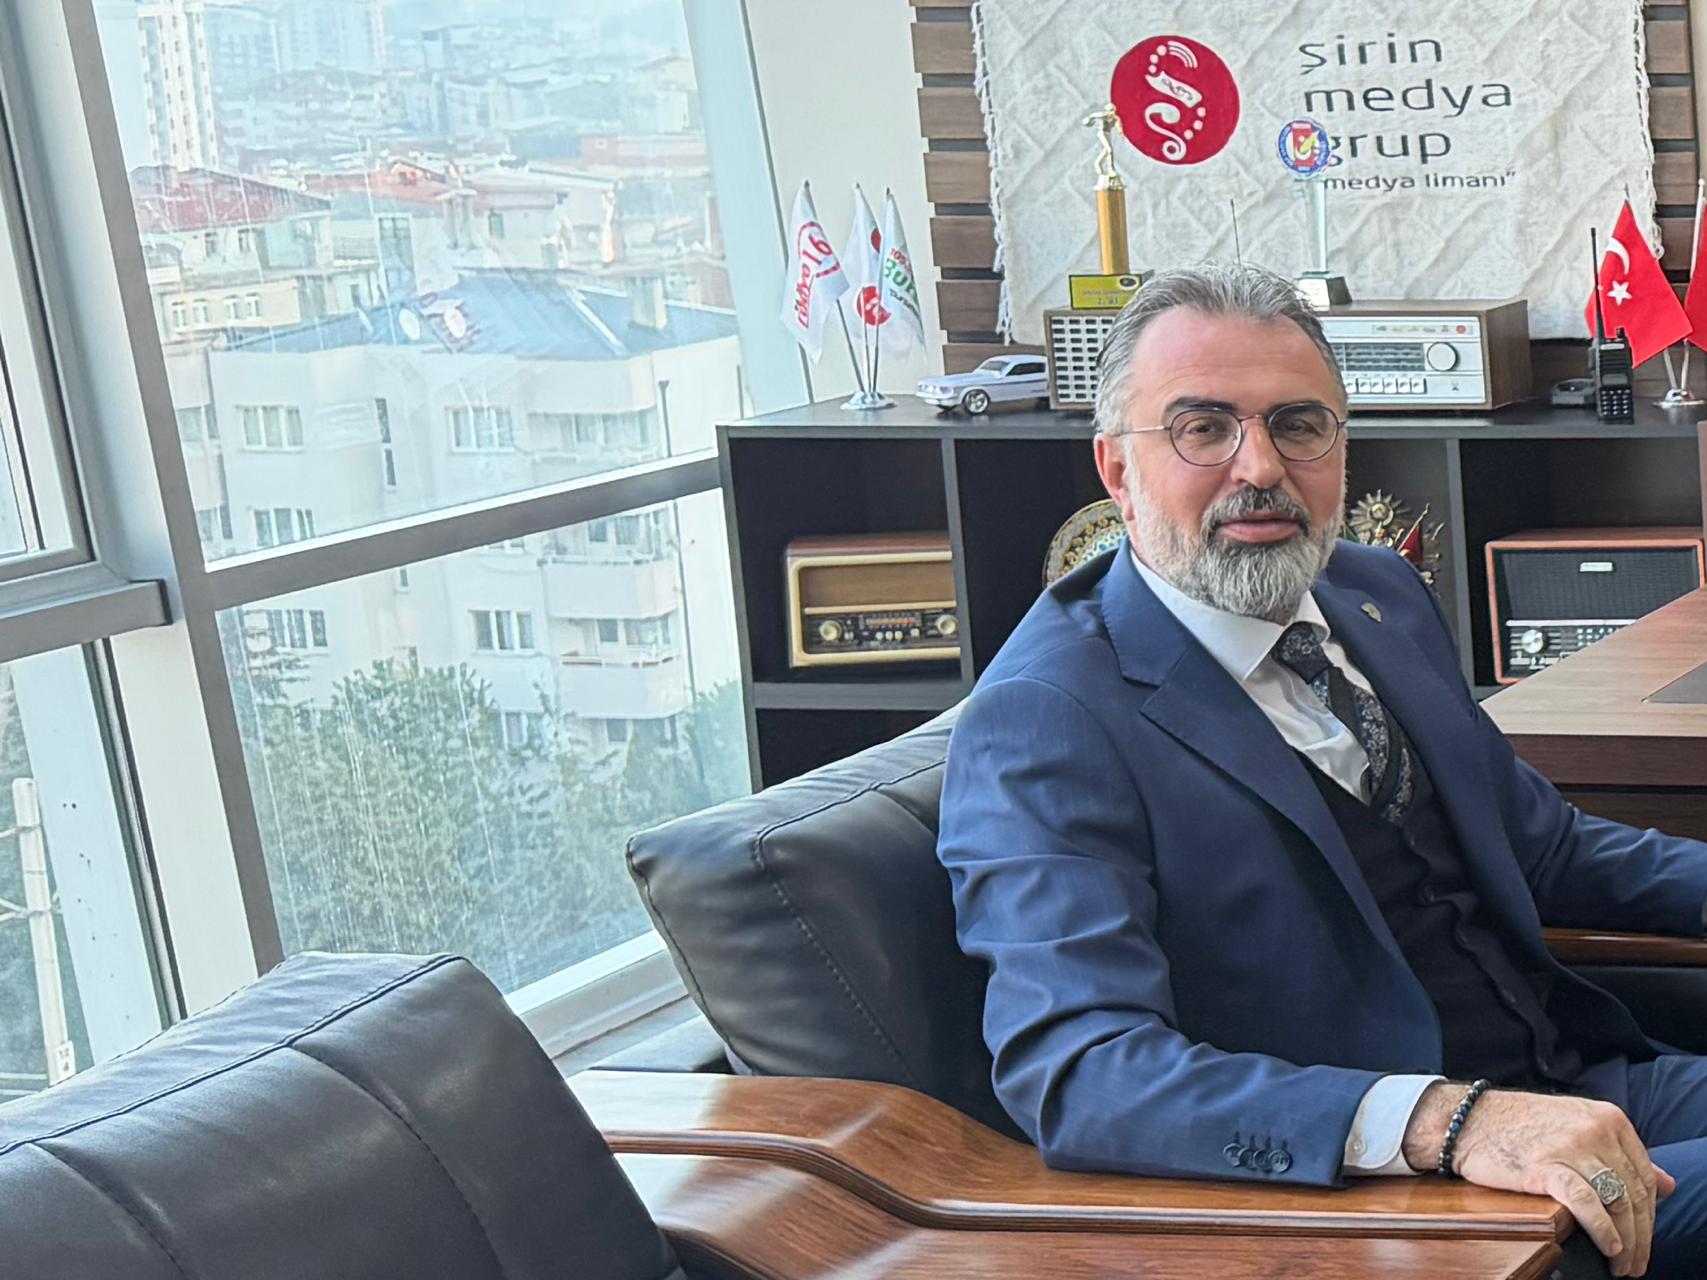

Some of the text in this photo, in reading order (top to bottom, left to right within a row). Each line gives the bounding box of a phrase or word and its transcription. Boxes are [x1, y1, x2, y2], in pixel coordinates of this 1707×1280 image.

[1298, 32, 1443, 76] şirin
[1303, 78, 1513, 119] medya
[1323, 173, 1416, 193] medya
